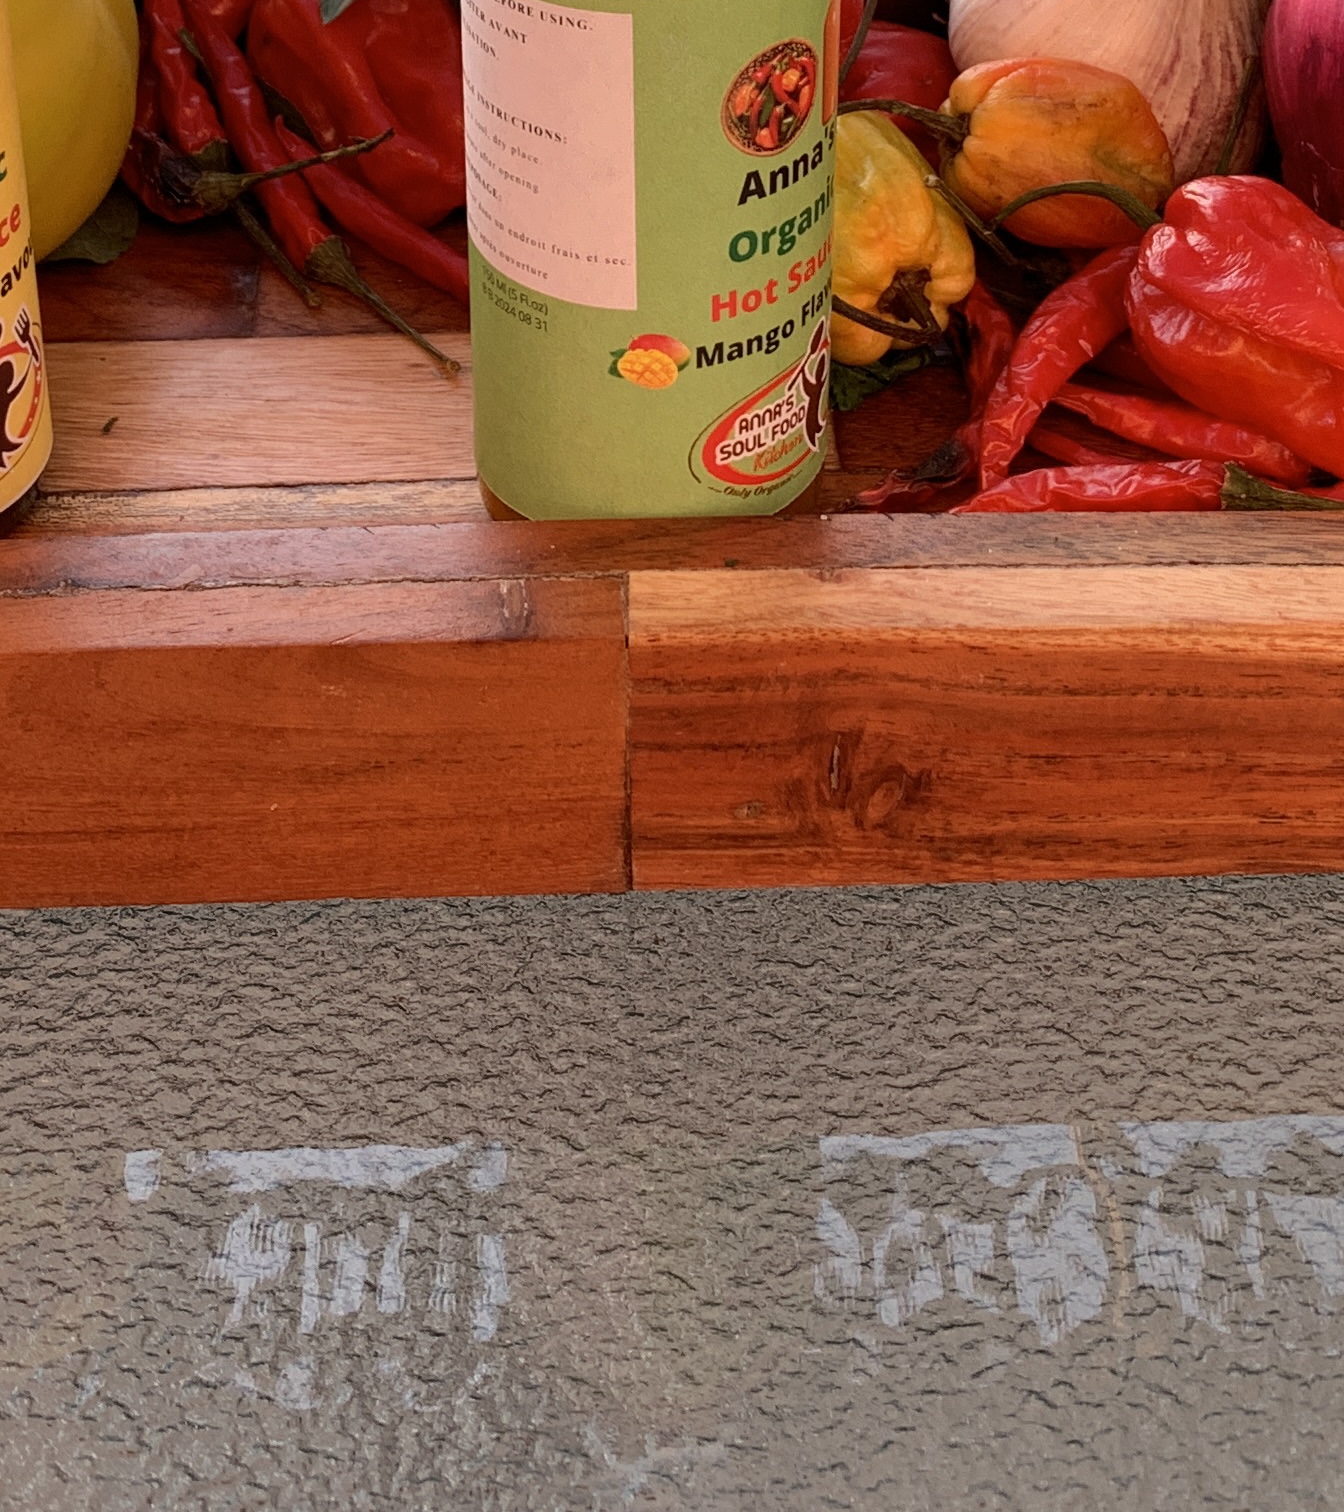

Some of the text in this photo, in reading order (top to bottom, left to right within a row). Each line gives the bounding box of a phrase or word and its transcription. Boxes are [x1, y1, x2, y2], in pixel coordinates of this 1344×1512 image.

[489, 19, 528, 44] AVANT
[540, 11, 593, 30] USING.
[477, 91, 567, 144] INSTRUCTIONS:
[498, 167, 539, 195] opening
[737, 120, 834, 206] Anna's
[499, 251, 548, 279] ouverture
[508, 228, 546, 250] endroit
[551, 244, 581, 260] frais
[605, 257, 631, 266] sec.
[495, 294, 516, 317] 2024
[518, 310, 532, 326] 08
[535, 317, 548, 332] 31
[711, 279, 778, 322] Hot
[696, 319, 794, 369] Mango
[720, 405, 805, 462] SOUL FOOD
[739, 394, 794, 435] ANNA'S
